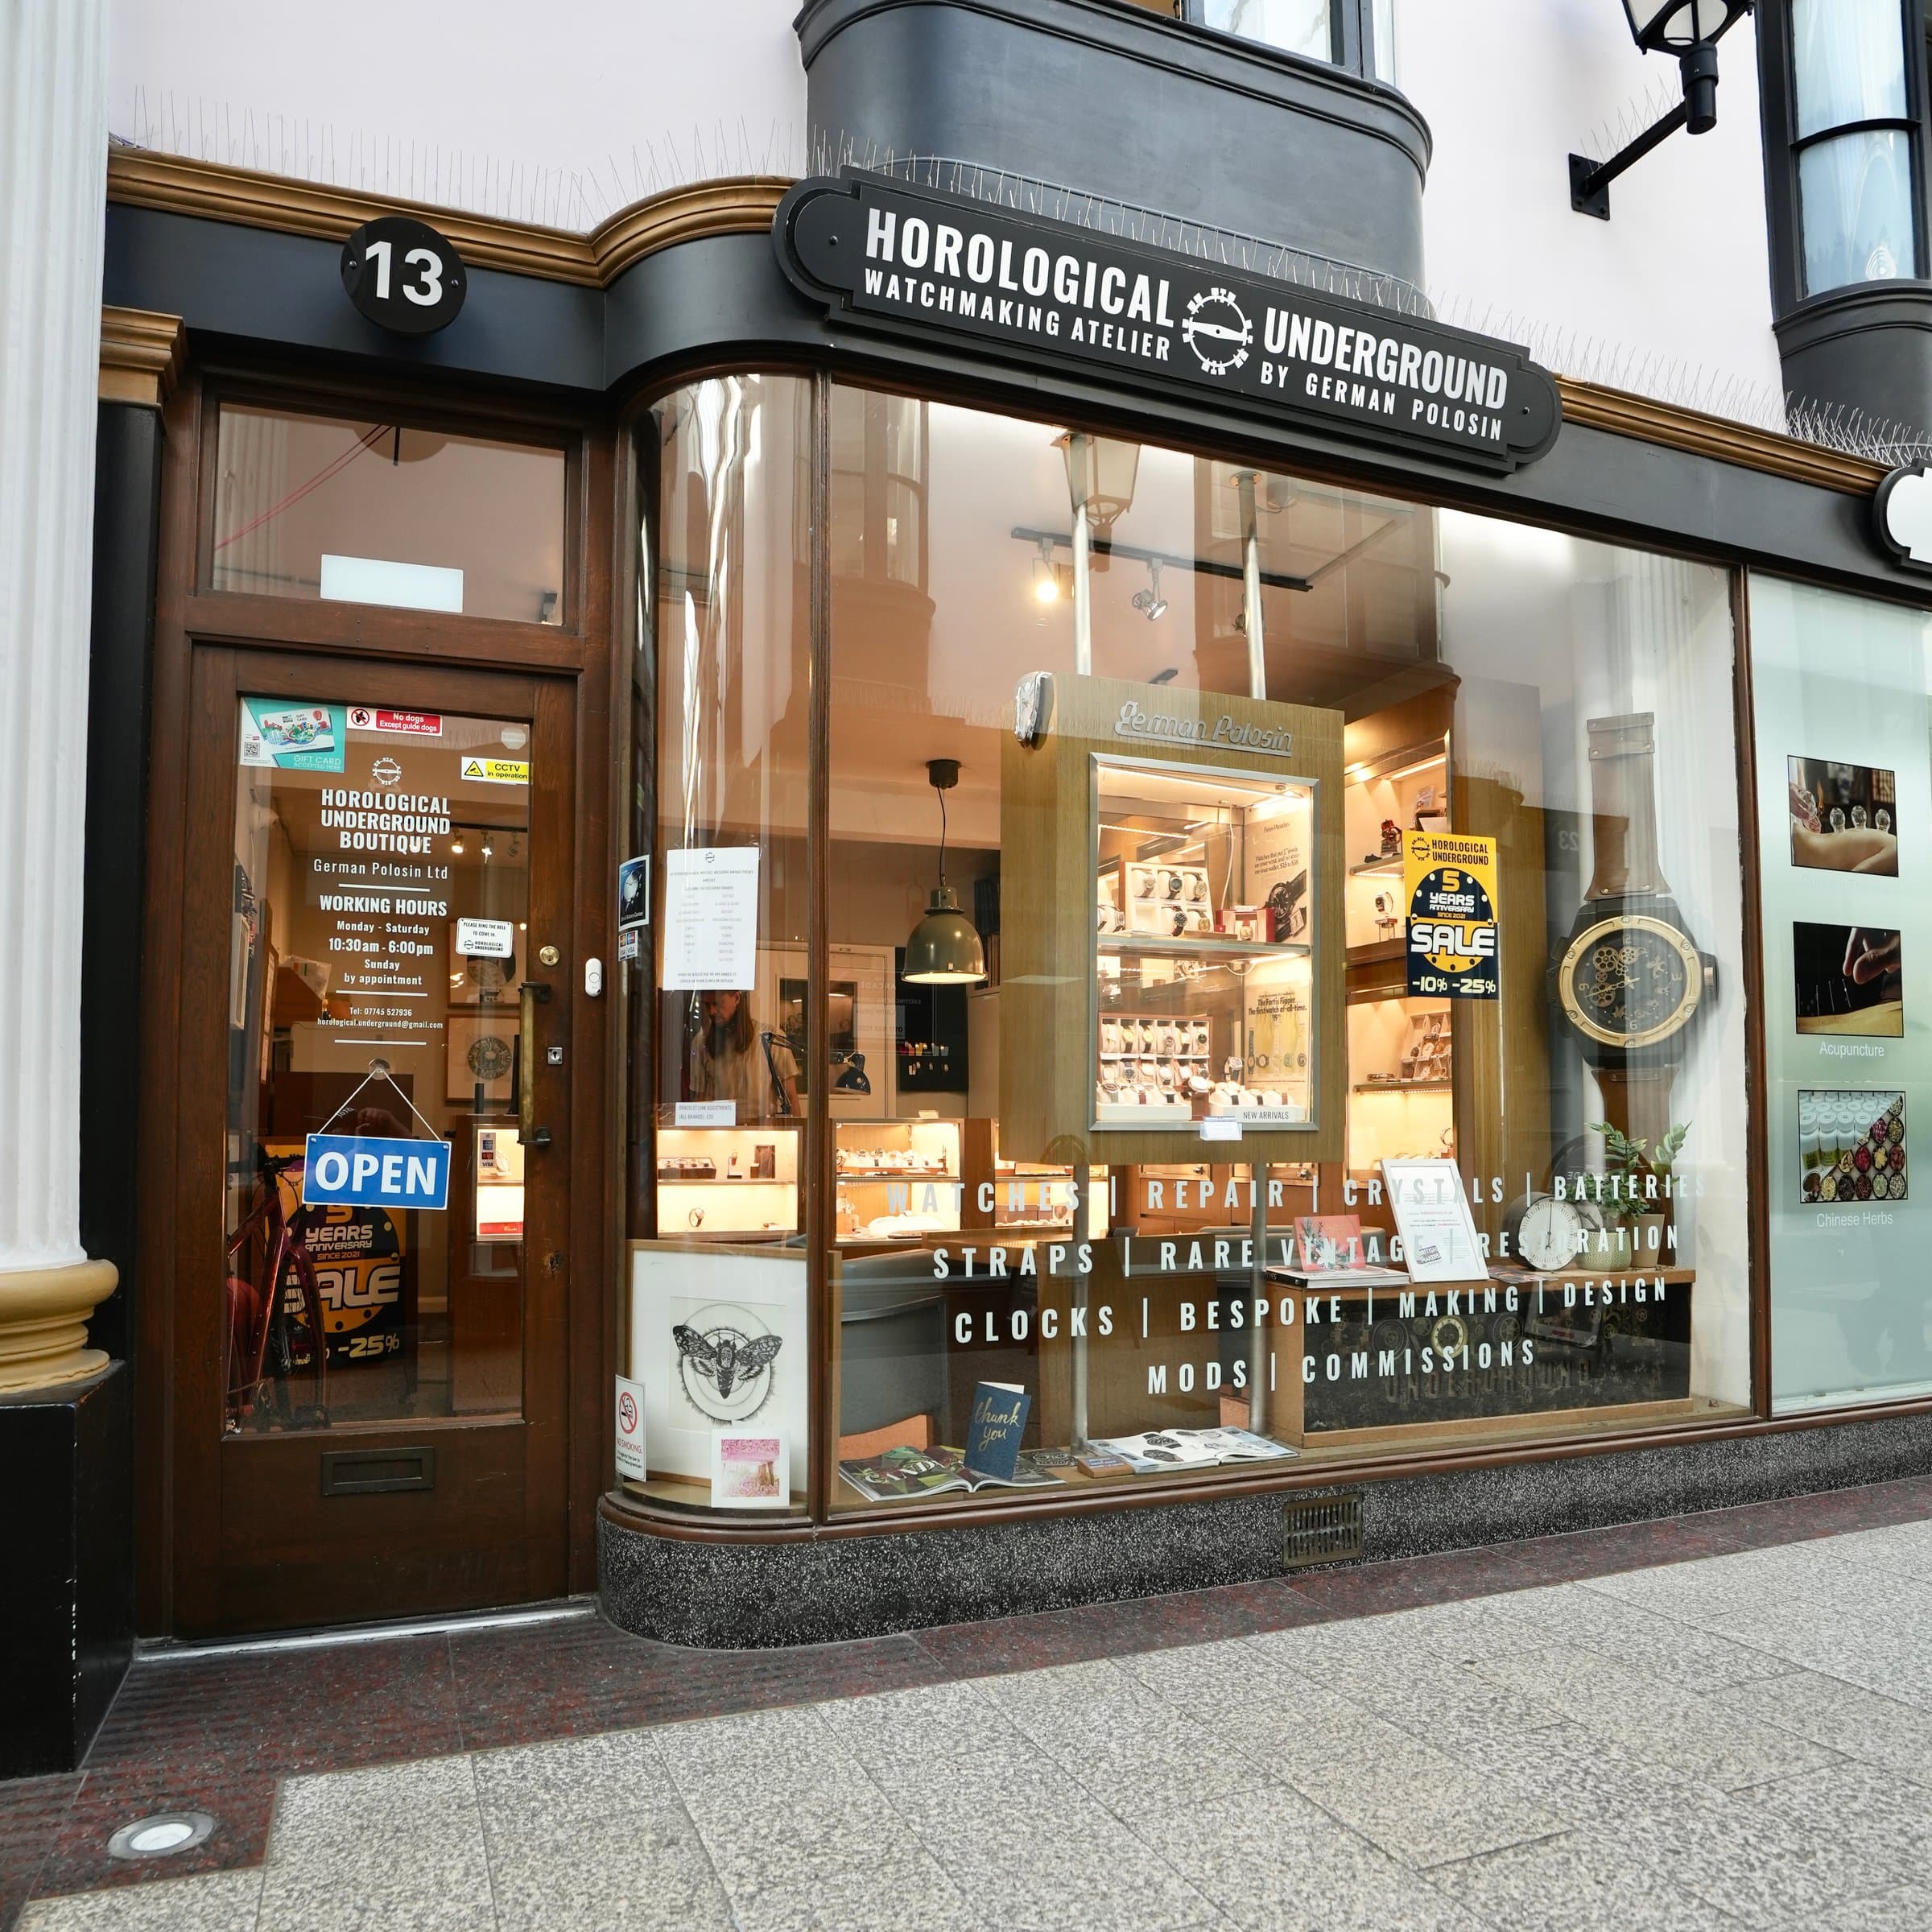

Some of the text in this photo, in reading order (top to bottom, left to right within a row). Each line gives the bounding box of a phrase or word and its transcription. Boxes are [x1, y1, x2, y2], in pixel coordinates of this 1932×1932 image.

[364, 241, 444, 307] 13
[865, 208, 1174, 328] HOROLOGICAL
[865, 267, 1170, 361] WATCHMAKING ATELIER
[1264, 307, 1508, 411] UNDERGROUND
[1260, 361, 1502, 442] BY GERMAN POLOSIN
[379, 720, 437, 733] Except guide dogs
[393, 712, 424, 724] No dogs
[1114, 700, 1293, 753] German Polosin
[293, 754, 341, 766] GIFT CARD
[494, 763, 520, 772] CCTV
[496, 771, 528, 779] operation
[321, 789, 451, 815] HOROLOGICAL
[321, 808, 451, 835] UNDERGROUND
[340, 831, 431, 854] BOUTIQUE
[1431, 839, 1488, 854] HOROLOGICAL
[1432, 851, 1488, 865] UNDERGROUND
[313, 858, 448, 880] German Polosin Ltd
[1442, 869, 1460, 892] 5
[320, 894, 448, 917] WORKING HOURS
[1429, 904, 1475, 913] ANNIVERSARY
[1430, 892, 1475, 906] YEARS
[336, 920, 374, 934] Monday
[386, 923, 430, 936] Saturday
[328, 937, 379, 953] 10:30am
[388, 940, 434, 956] 6:00pm
[1410, 923, 1495, 957] SALE
[364, 959, 400, 972] Sunday
[344, 973, 423, 986] by appointment
[1412, 976, 1496, 994] -10% -25%
[349, 1006, 413, 1017] Tel: 07745 527936
[317, 1018, 444, 1030] horological.underground@gmail.com
[1818, 1041, 1885, 1059] Acupuncture
[1243, 1111, 1257, 1120] NEW
[1259, 1111, 1290, 1120] ARRIVALS
[314, 1151, 437, 1195] OPEN
[886, 1182, 1080, 1212] WATCHES
[1147, 1180, 1283, 1209] REPAIR
[1344, 1176, 1505, 1207] CRYSTALS
[1554, 1172, 1705, 1202] BATTERIES
[1816, 1212, 1893, 1228] Chinese Herbs
[304, 1224, 374, 1244] YEARS
[304, 1241, 373, 1253] ANNIVERSARY
[317, 1250, 361, 1261] SINCE 2021
[933, 1245, 1093, 1279] STRAPS
[1160, 1239, 1253, 1271] RARE
[955, 1306, 1113, 1344] CLOCKS
[1179, 1295, 1342, 1331] BESPOKE
[1399, 1286, 1519, 1319] MAKING
[1564, 1277, 1666, 1307] DESIGN
[337, 1332, 400, 1359] -25%
[1148, 1359, 1247, 1394] MODS
[1302, 1339, 1534, 1384] COMMISSIONS
[975, 1397, 1021, 1427] thank
[979, 1426, 1007, 1451] you
